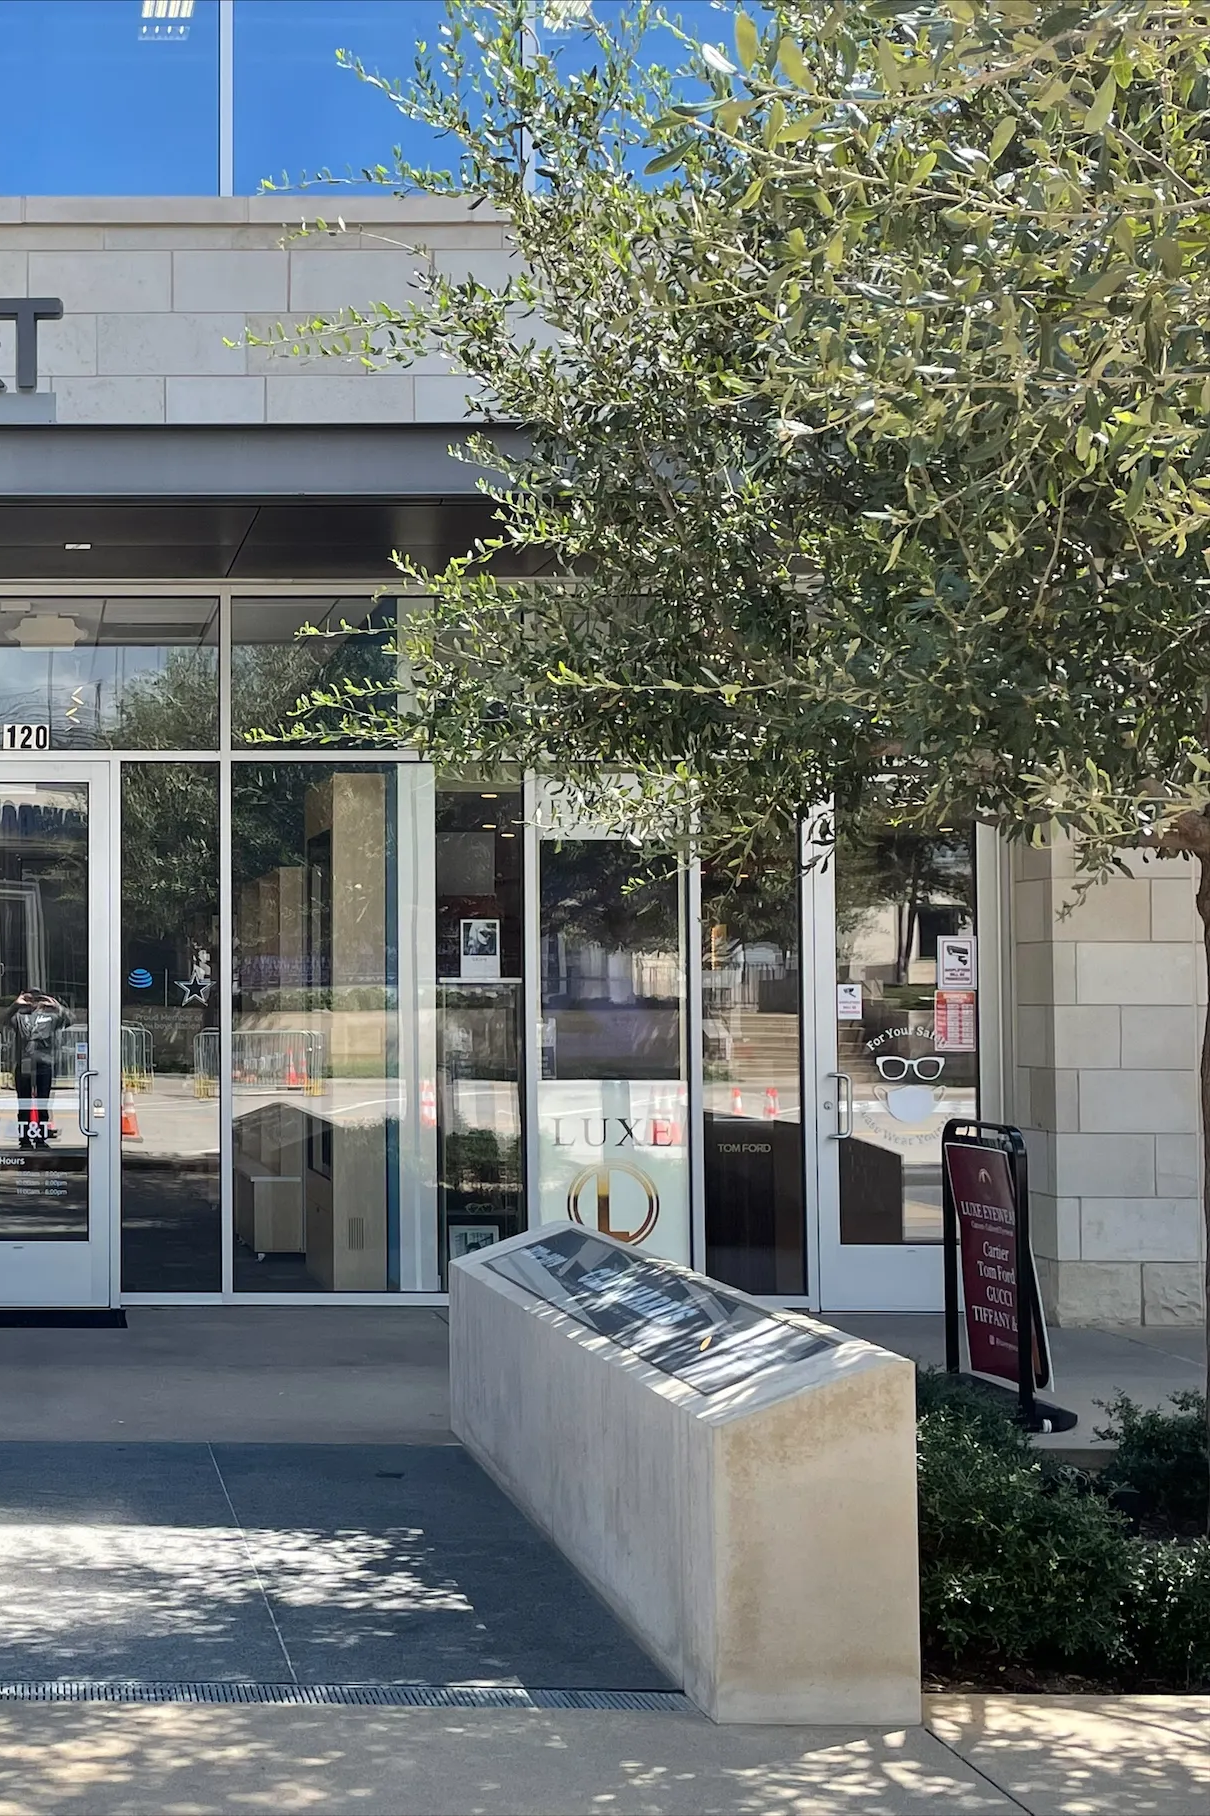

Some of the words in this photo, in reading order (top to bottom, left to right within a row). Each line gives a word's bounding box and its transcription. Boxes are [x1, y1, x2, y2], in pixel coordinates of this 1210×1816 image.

[7, 725, 47, 749] 120
[865, 1034, 886, 1051] For
[885, 1027, 914, 1040] Your
[551, 1118, 674, 1147] LUXE
[718, 1143, 741, 1152] TOM
[742, 1143, 772, 1153] FORD
[0, 1156, 25, 1165] Hours
[961, 1201, 983, 1219] LUXE
[982, 1204, 1016, 1226] EYEWEA
[983, 1241, 1009, 1261] Cartier
[977, 1260, 997, 1280] Tom
[997, 1265, 1017, 1285] Ford
[986, 1285, 1013, 1307] GUCCI
[971, 1305, 1011, 1330] TIFFANY
